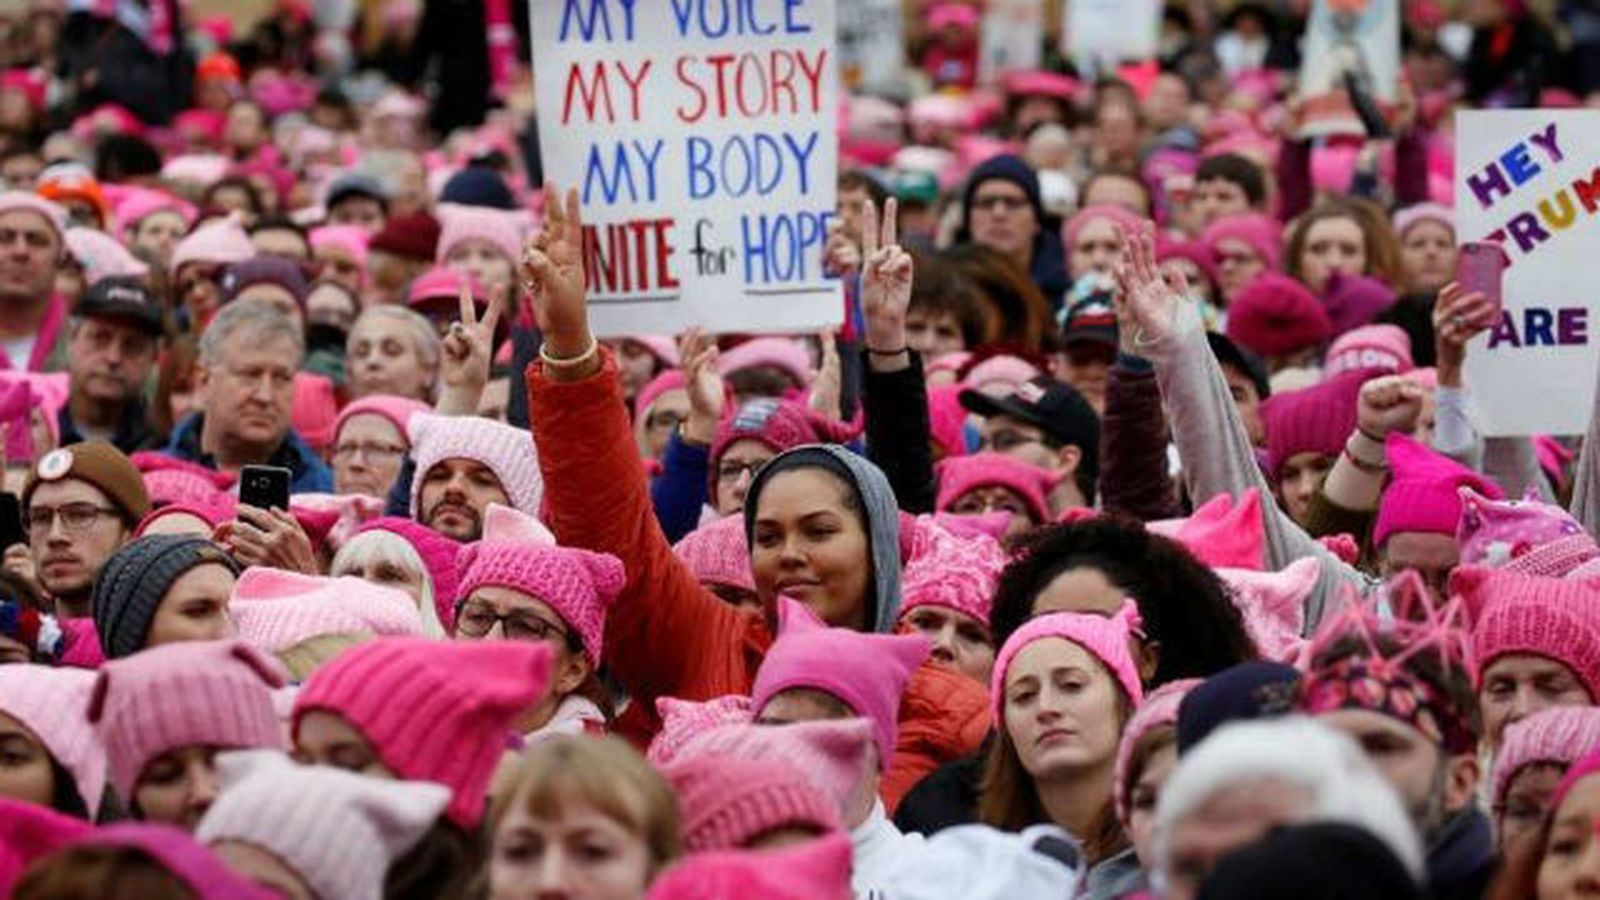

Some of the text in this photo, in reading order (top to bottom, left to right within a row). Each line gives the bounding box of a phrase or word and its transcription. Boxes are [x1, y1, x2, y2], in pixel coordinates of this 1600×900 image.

[558, 0, 635, 42] MY
[672, 0, 812, 39] VOICE
[562, 49, 827, 125] MY STORY
[582, 132, 819, 205] MY BODY
[1466, 122, 1564, 210] HEY
[690, 218, 736, 276] for
[1487, 307, 1588, 349] ARE
